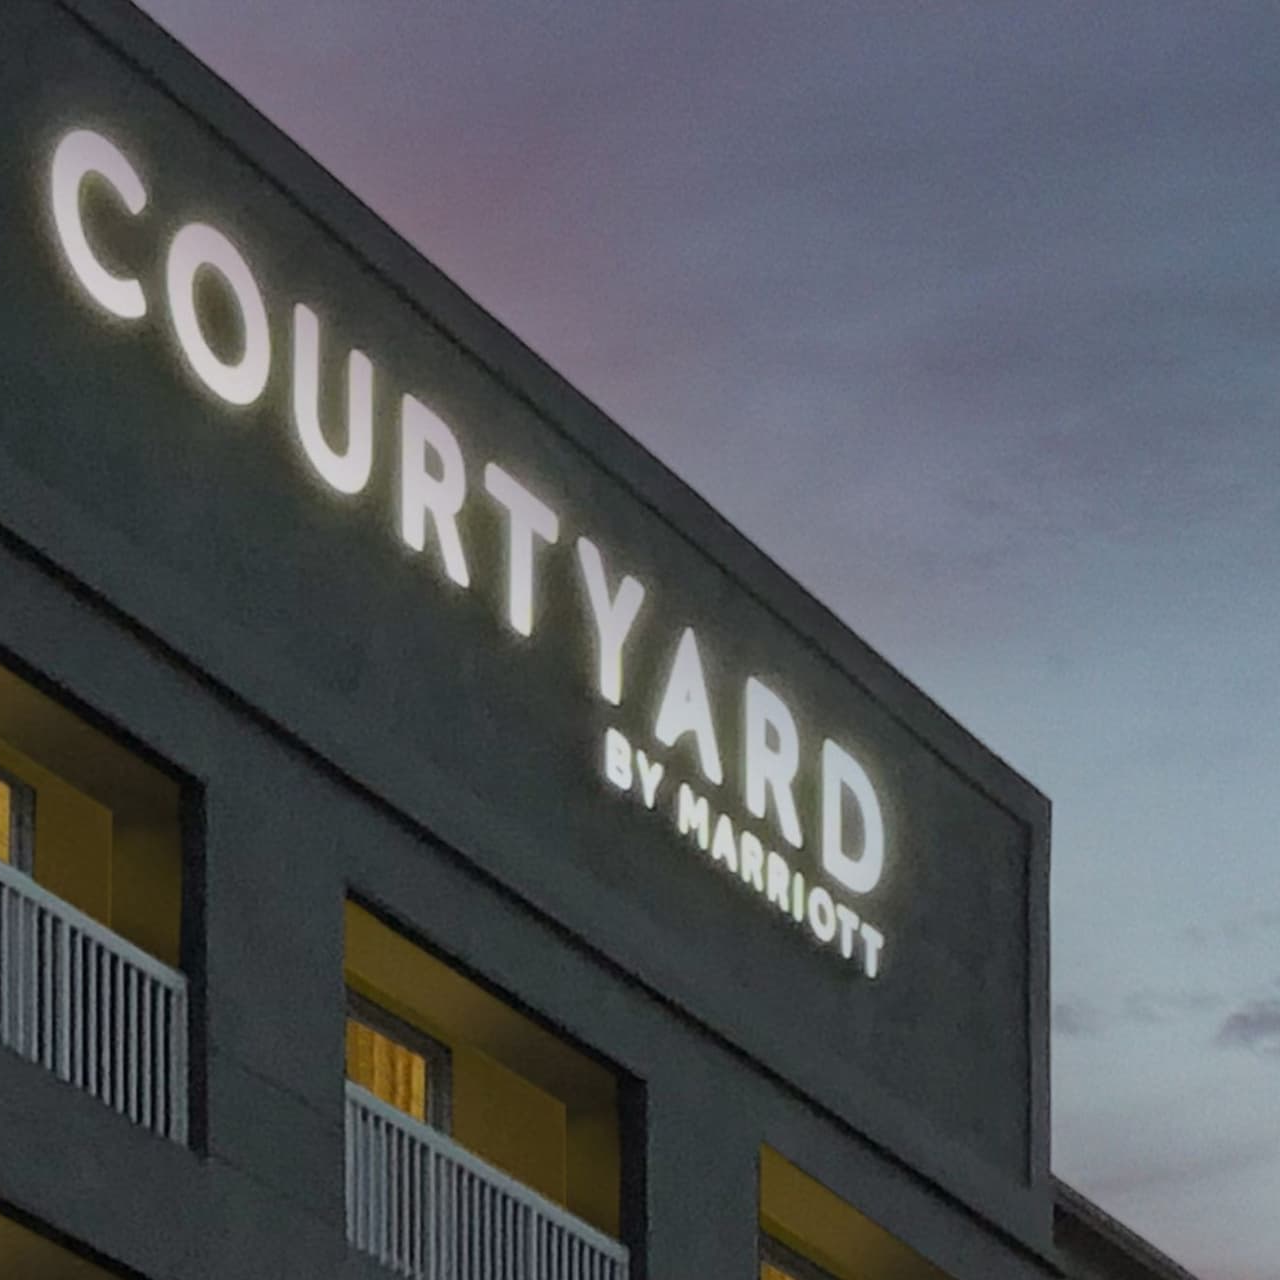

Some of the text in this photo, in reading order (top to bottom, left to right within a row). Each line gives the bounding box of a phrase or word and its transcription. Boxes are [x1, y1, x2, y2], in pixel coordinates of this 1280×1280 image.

[49, 129, 887, 895] COURTYARD
[603, 727, 886, 979] BY MARRIOTT
